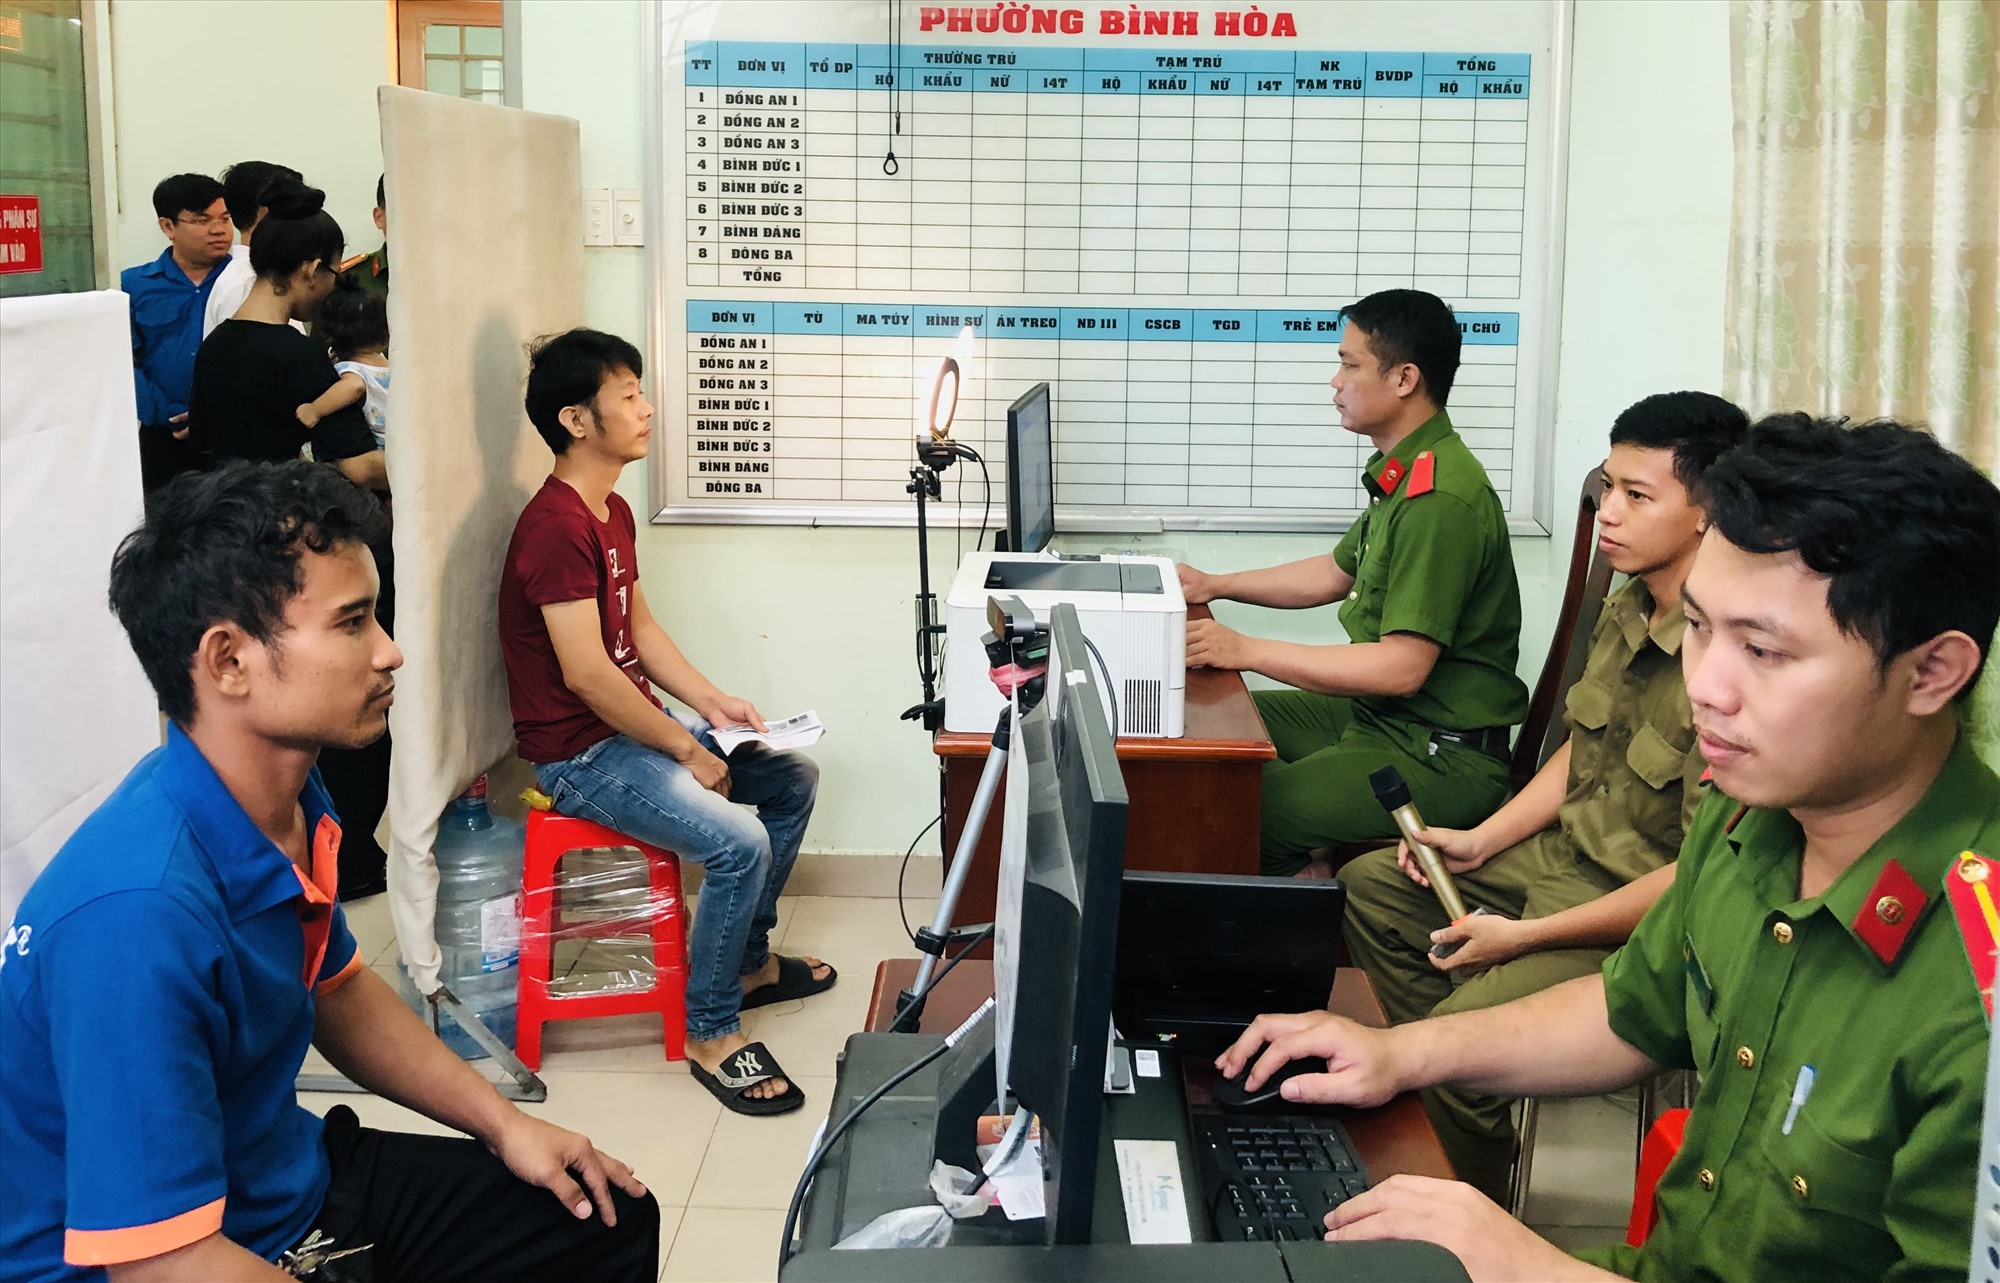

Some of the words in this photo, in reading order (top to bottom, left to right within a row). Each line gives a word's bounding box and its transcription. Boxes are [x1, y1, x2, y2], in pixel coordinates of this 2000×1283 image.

[920, 3, 1083, 34] PHƯỜNG
[1099, 4, 1198, 36] BÌNH
[1214, 5, 1297, 36] HÒA
[692, 60, 711, 70] TT
[810, 57, 829, 73] TỔ
[833, 63, 853, 73] DP
[924, 52, 981, 64] THƯỜNG
[988, 53, 1016, 65] TRÚ
[1156, 56, 1187, 70] TẠM
[1192, 56, 1222, 67] TRÚ
[1320, 60, 1339, 71] NK
[1457, 55, 1496, 71] TỔNG
[738, 59, 766, 72] ĐƠN
[771, 60, 785, 73] VỊ
[875, 73, 894, 88] HỘ
[923, 74, 962, 87] KHẨU
[990, 74, 1010, 87] NỮ
[1148, 76, 1187, 90] KHẨU
[1375, 70, 1413, 82] BVDP
[1102, 76, 1120, 91] HỘ
[1210, 77, 1231, 91] NỮ
[1297, 79, 1327, 92] TẠM
[1333, 77, 1362, 90] TRÚ
[1440, 81, 1458, 95] HỘ
[1483, 79, 1522, 94] KHẨU
[698, 93, 704, 103] 1
[725, 91, 763, 106] ĐỒNG
[766, 95, 787, 106] AN
[792, 96, 798, 106] 1
[697, 115, 706, 125] 2
[723, 113, 761, 128] ĐỒNG
[765, 117, 786, 128] AN
[790, 118, 800, 128] 2
[697, 137, 706, 147] 3
[723, 134, 761, 149] ĐỒNG
[765, 139, 786, 149] AN
[790, 139, 800, 150] 3
[697, 159, 706, 170] 4
[723, 157, 758, 171] BÌNH
[762, 157, 790, 172] ĐỨC
[795, 162, 800, 172] 1
[697, 182, 706, 192] 5
[721, 180, 756, 193] BÌNH
[760, 180, 789, 194] ĐỨC
[793, 184, 802, 194] 2
[697, 204, 706, 215] 6
[721, 202, 756, 216] BÌNH
[760, 202, 789, 216] ĐỨC
[793, 206, 802, 216] 3
[3, 205, 25, 233] PHẬN
[26, 208, 37, 233] SỰ
[698, 226, 707, 236] 7
[723, 224, 759, 238] BÌNH
[763, 225, 801, 239] ĐÁNG
[10, 239, 26, 263] VÀO
[698, 248, 707, 258] 8
[731, 246, 770, 260] ĐÔNG
[774, 250, 793, 260] BA
[743, 268, 781, 282] TỔNG
[712, 312, 738, 323] ĐƠN
[742, 313, 755, 325] VỊ
[804, 310, 822, 324] TÙ
[857, 314, 878, 325] MA
[882, 312, 909, 325] TÚY
[926, 312, 959, 326] HÌNH
[964, 314, 984, 328] SỰ
[996, 314, 1016, 327] ÁN
[1020, 318, 1057, 327] TREO
[1077, 319, 1096, 329] NĐ
[1283, 317, 1312, 331] TRẺ
[1317, 322, 1336, 331] EM
[1145, 320, 1180, 329] CSCB
[1213, 320, 1240, 330] TGD
[1472, 320, 1500, 334] CHÚ
[700, 335, 735, 348] ĐỒNG
[740, 339, 759, 348] AN
[762, 339, 766, 348] 1
[699, 356, 734, 369] ĐỒNG
[739, 360, 757, 369] AN
[760, 360, 768, 369] 2
[699, 376, 734, 389] ĐỒNG
[739, 380, 757, 390] AN
[760, 380, 768, 390] 3
[698, 397, 730, 410] BÌNH
[734, 397, 761, 410] ĐỨC
[764, 400, 769, 410] 1
[697, 418, 728, 431] BÌNH
[732, 417, 759, 431] ĐỨC
[762, 421, 771, 431] 2
[697, 438, 728, 451] BÌNH
[732, 438, 759, 452] ĐỨC
[762, 442, 771, 452] 3
[698, 459, 731, 472] BÌNH
[734, 460, 769, 473] ĐÁNG
[706, 479, 741, 493] ĐÔNG
[744, 483, 762, 493] BA
